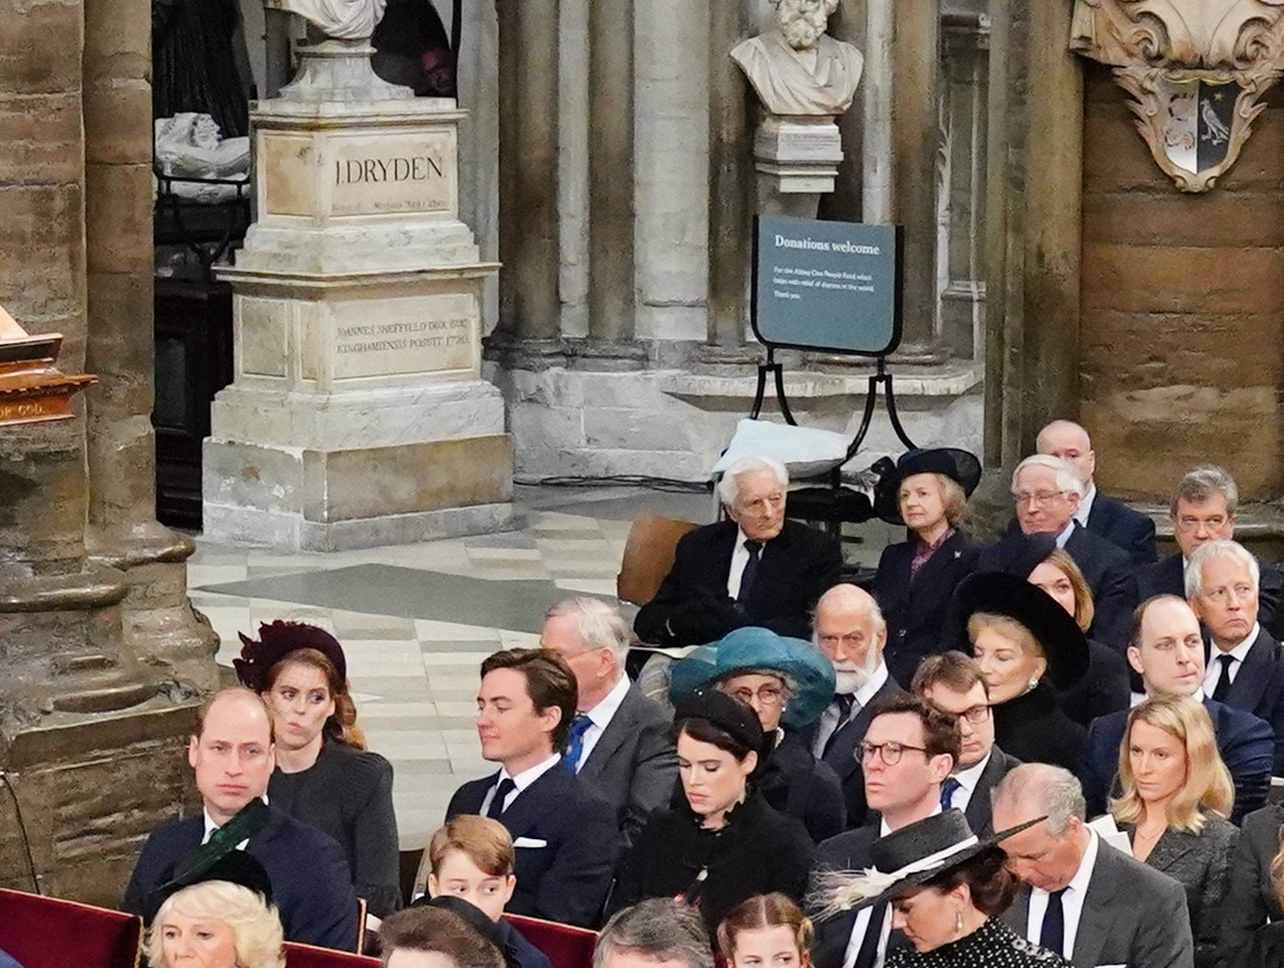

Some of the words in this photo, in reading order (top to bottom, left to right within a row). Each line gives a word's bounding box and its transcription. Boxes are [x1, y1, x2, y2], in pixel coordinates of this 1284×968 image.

[775, 234, 830, 251] Donations
[832, 241, 880, 255] welcome
[774, 266, 784, 274] For
